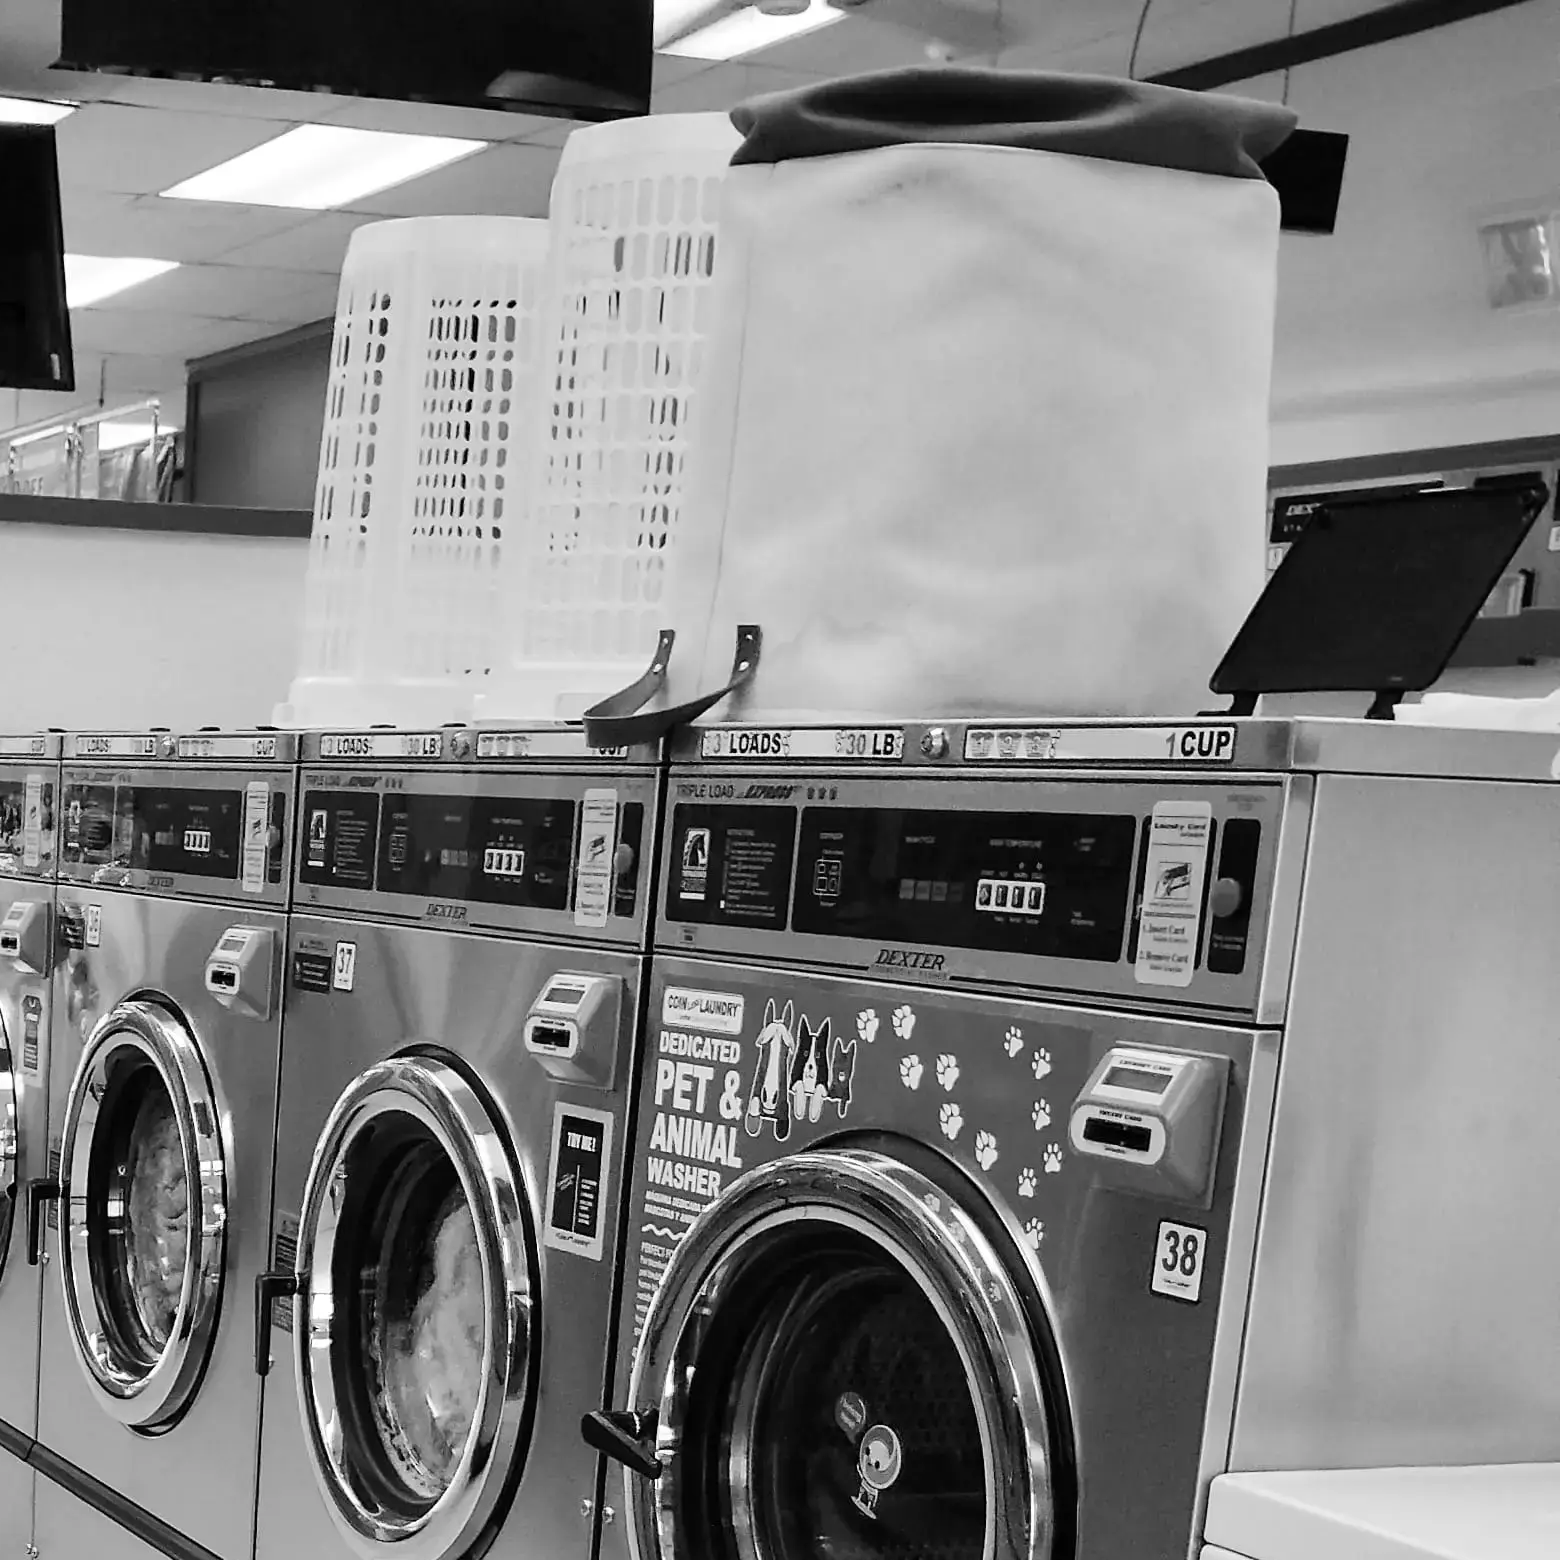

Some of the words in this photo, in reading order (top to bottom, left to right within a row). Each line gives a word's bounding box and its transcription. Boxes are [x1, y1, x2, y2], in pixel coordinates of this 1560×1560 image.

[337, 738, 369, 755] LOADS
[423, 738, 436, 755] LB
[729, 733, 781, 755] LOADS
[846, 734, 867, 755] 30
[872, 733, 895, 756] LB
[1165, 732, 1175, 758] 1
[1181, 731, 1231, 758] CUP
[709, 785, 734, 799] LOAD
[875, 948, 945, 972] DEXTER
[700, 1000, 741, 1017] LAUNDRY
[659, 1031, 741, 1064] DEDICATED
[654, 1058, 715, 1114] PET
[719, 1070, 743, 1121] &
[649, 1111, 743, 1169] ANIMAL
[647, 1155, 721, 1199] WASHER
[1161, 1230, 1198, 1277] 38
